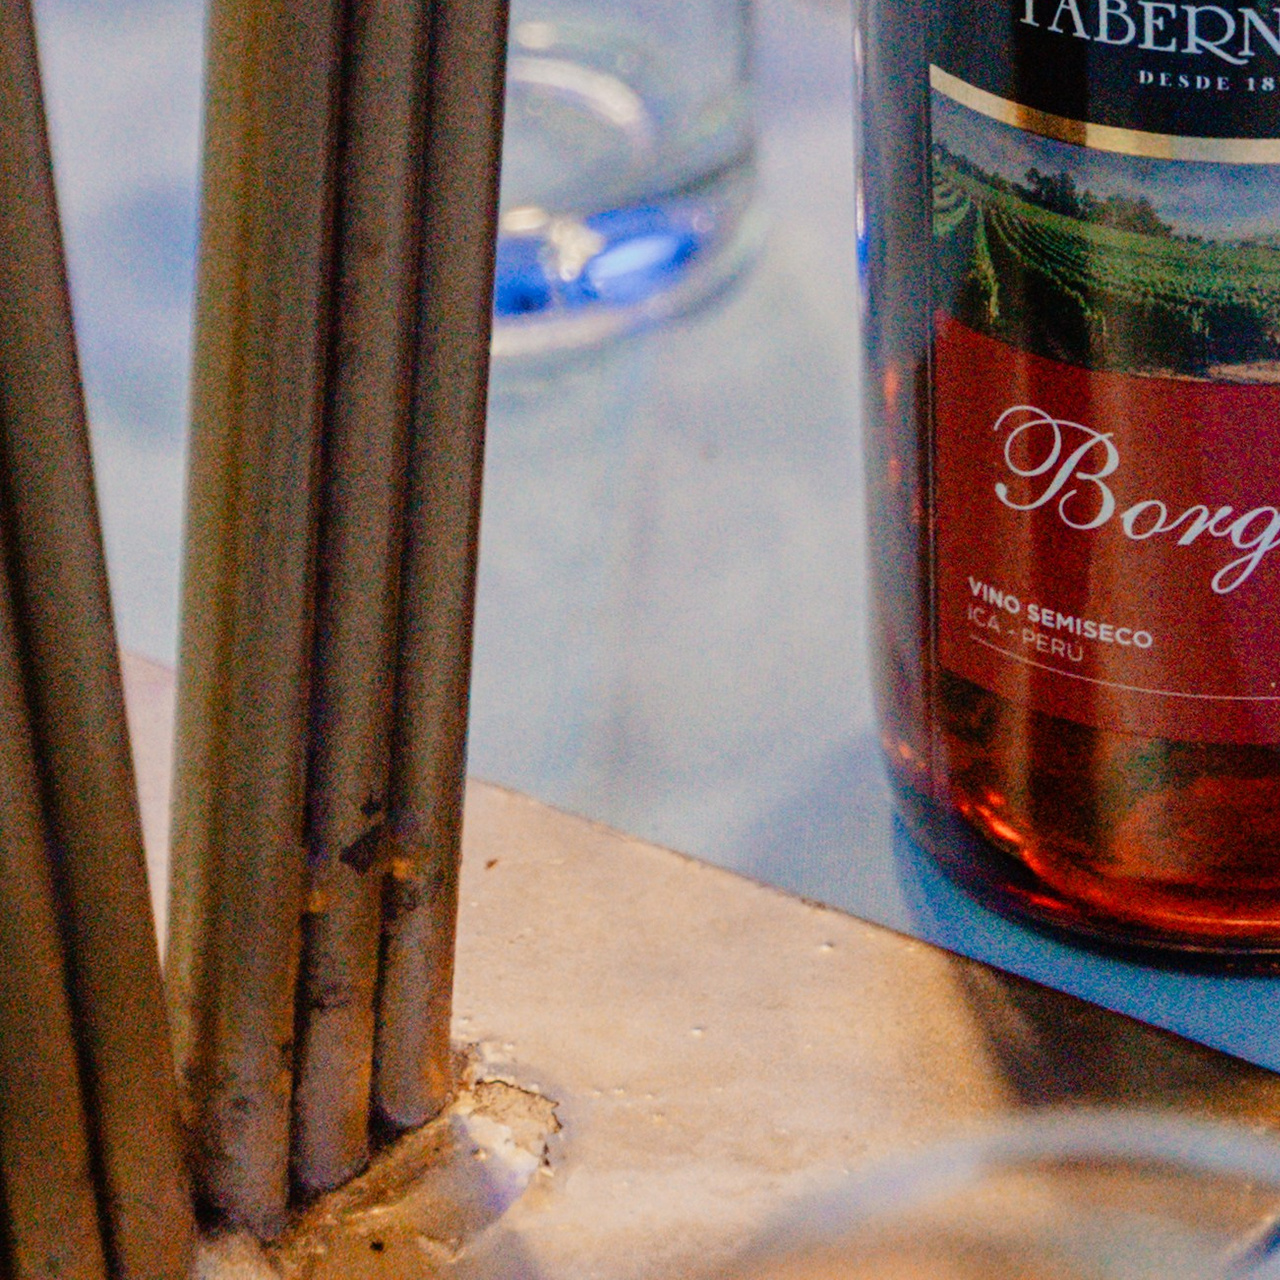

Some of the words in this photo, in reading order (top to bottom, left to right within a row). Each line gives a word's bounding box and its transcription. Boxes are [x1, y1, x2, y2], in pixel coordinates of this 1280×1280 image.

[1139, 70, 1230, 90] DESDE
[967, 605, 1000, 635] ICA
[968, 576, 1021, 614] VINO
[1027, 603, 1153, 648] SEMISECO
